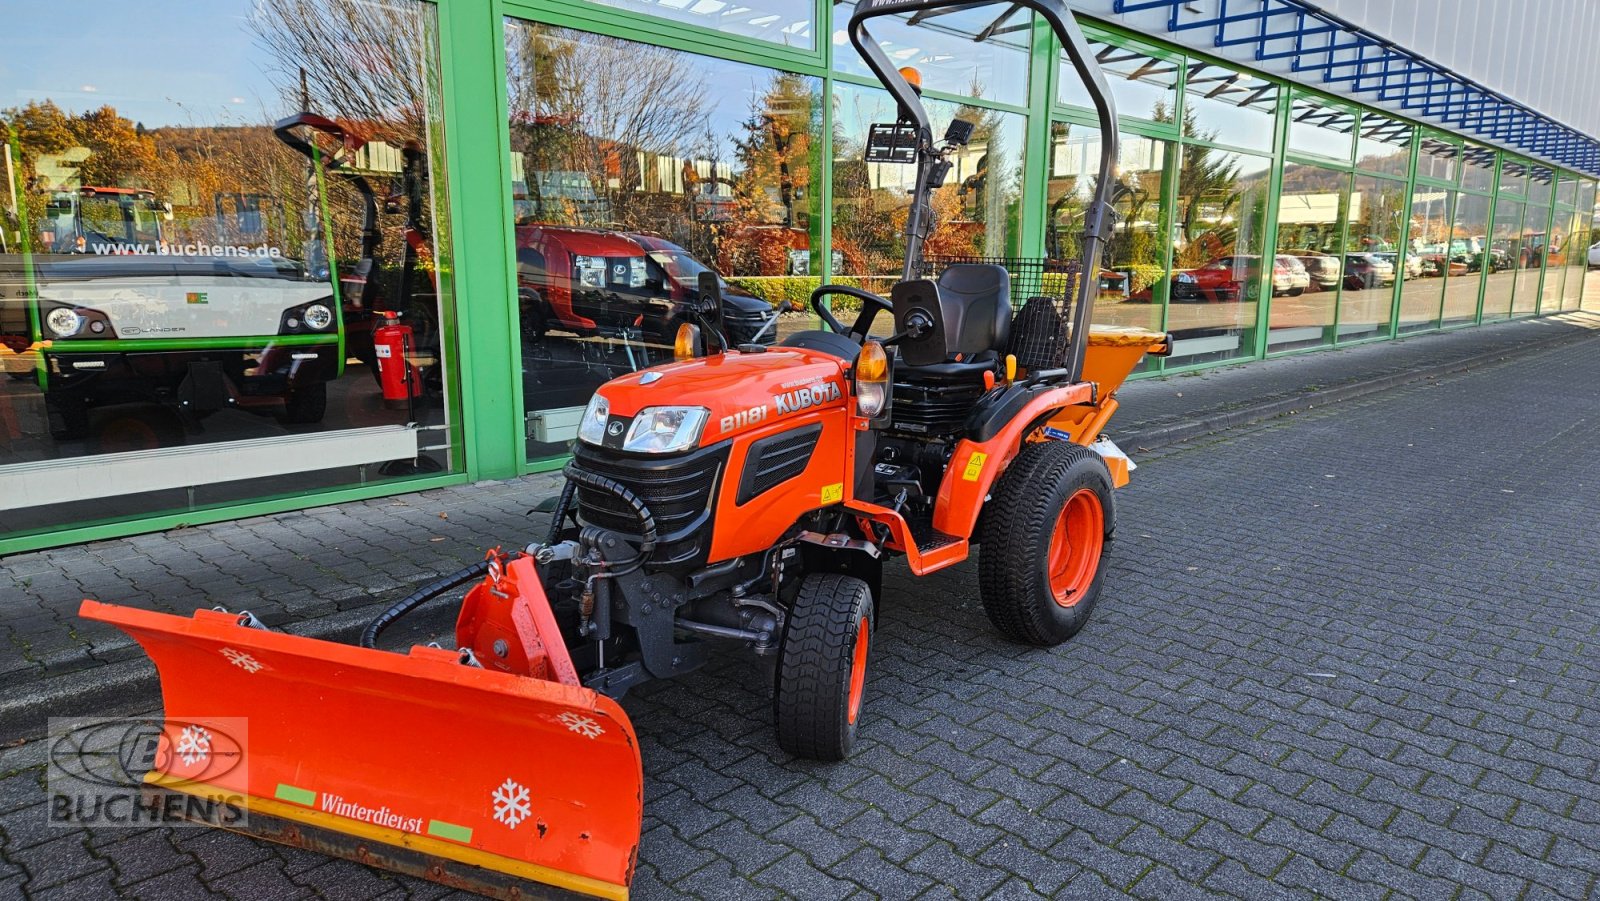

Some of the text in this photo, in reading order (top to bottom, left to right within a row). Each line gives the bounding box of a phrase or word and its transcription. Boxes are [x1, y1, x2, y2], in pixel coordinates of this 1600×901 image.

[92, 240, 281, 258] www.buchens.de
[774, 382, 842, 416] KUBOTA
[720, 405, 768, 434] B1181
[322, 792, 424, 834] Winterdienst
